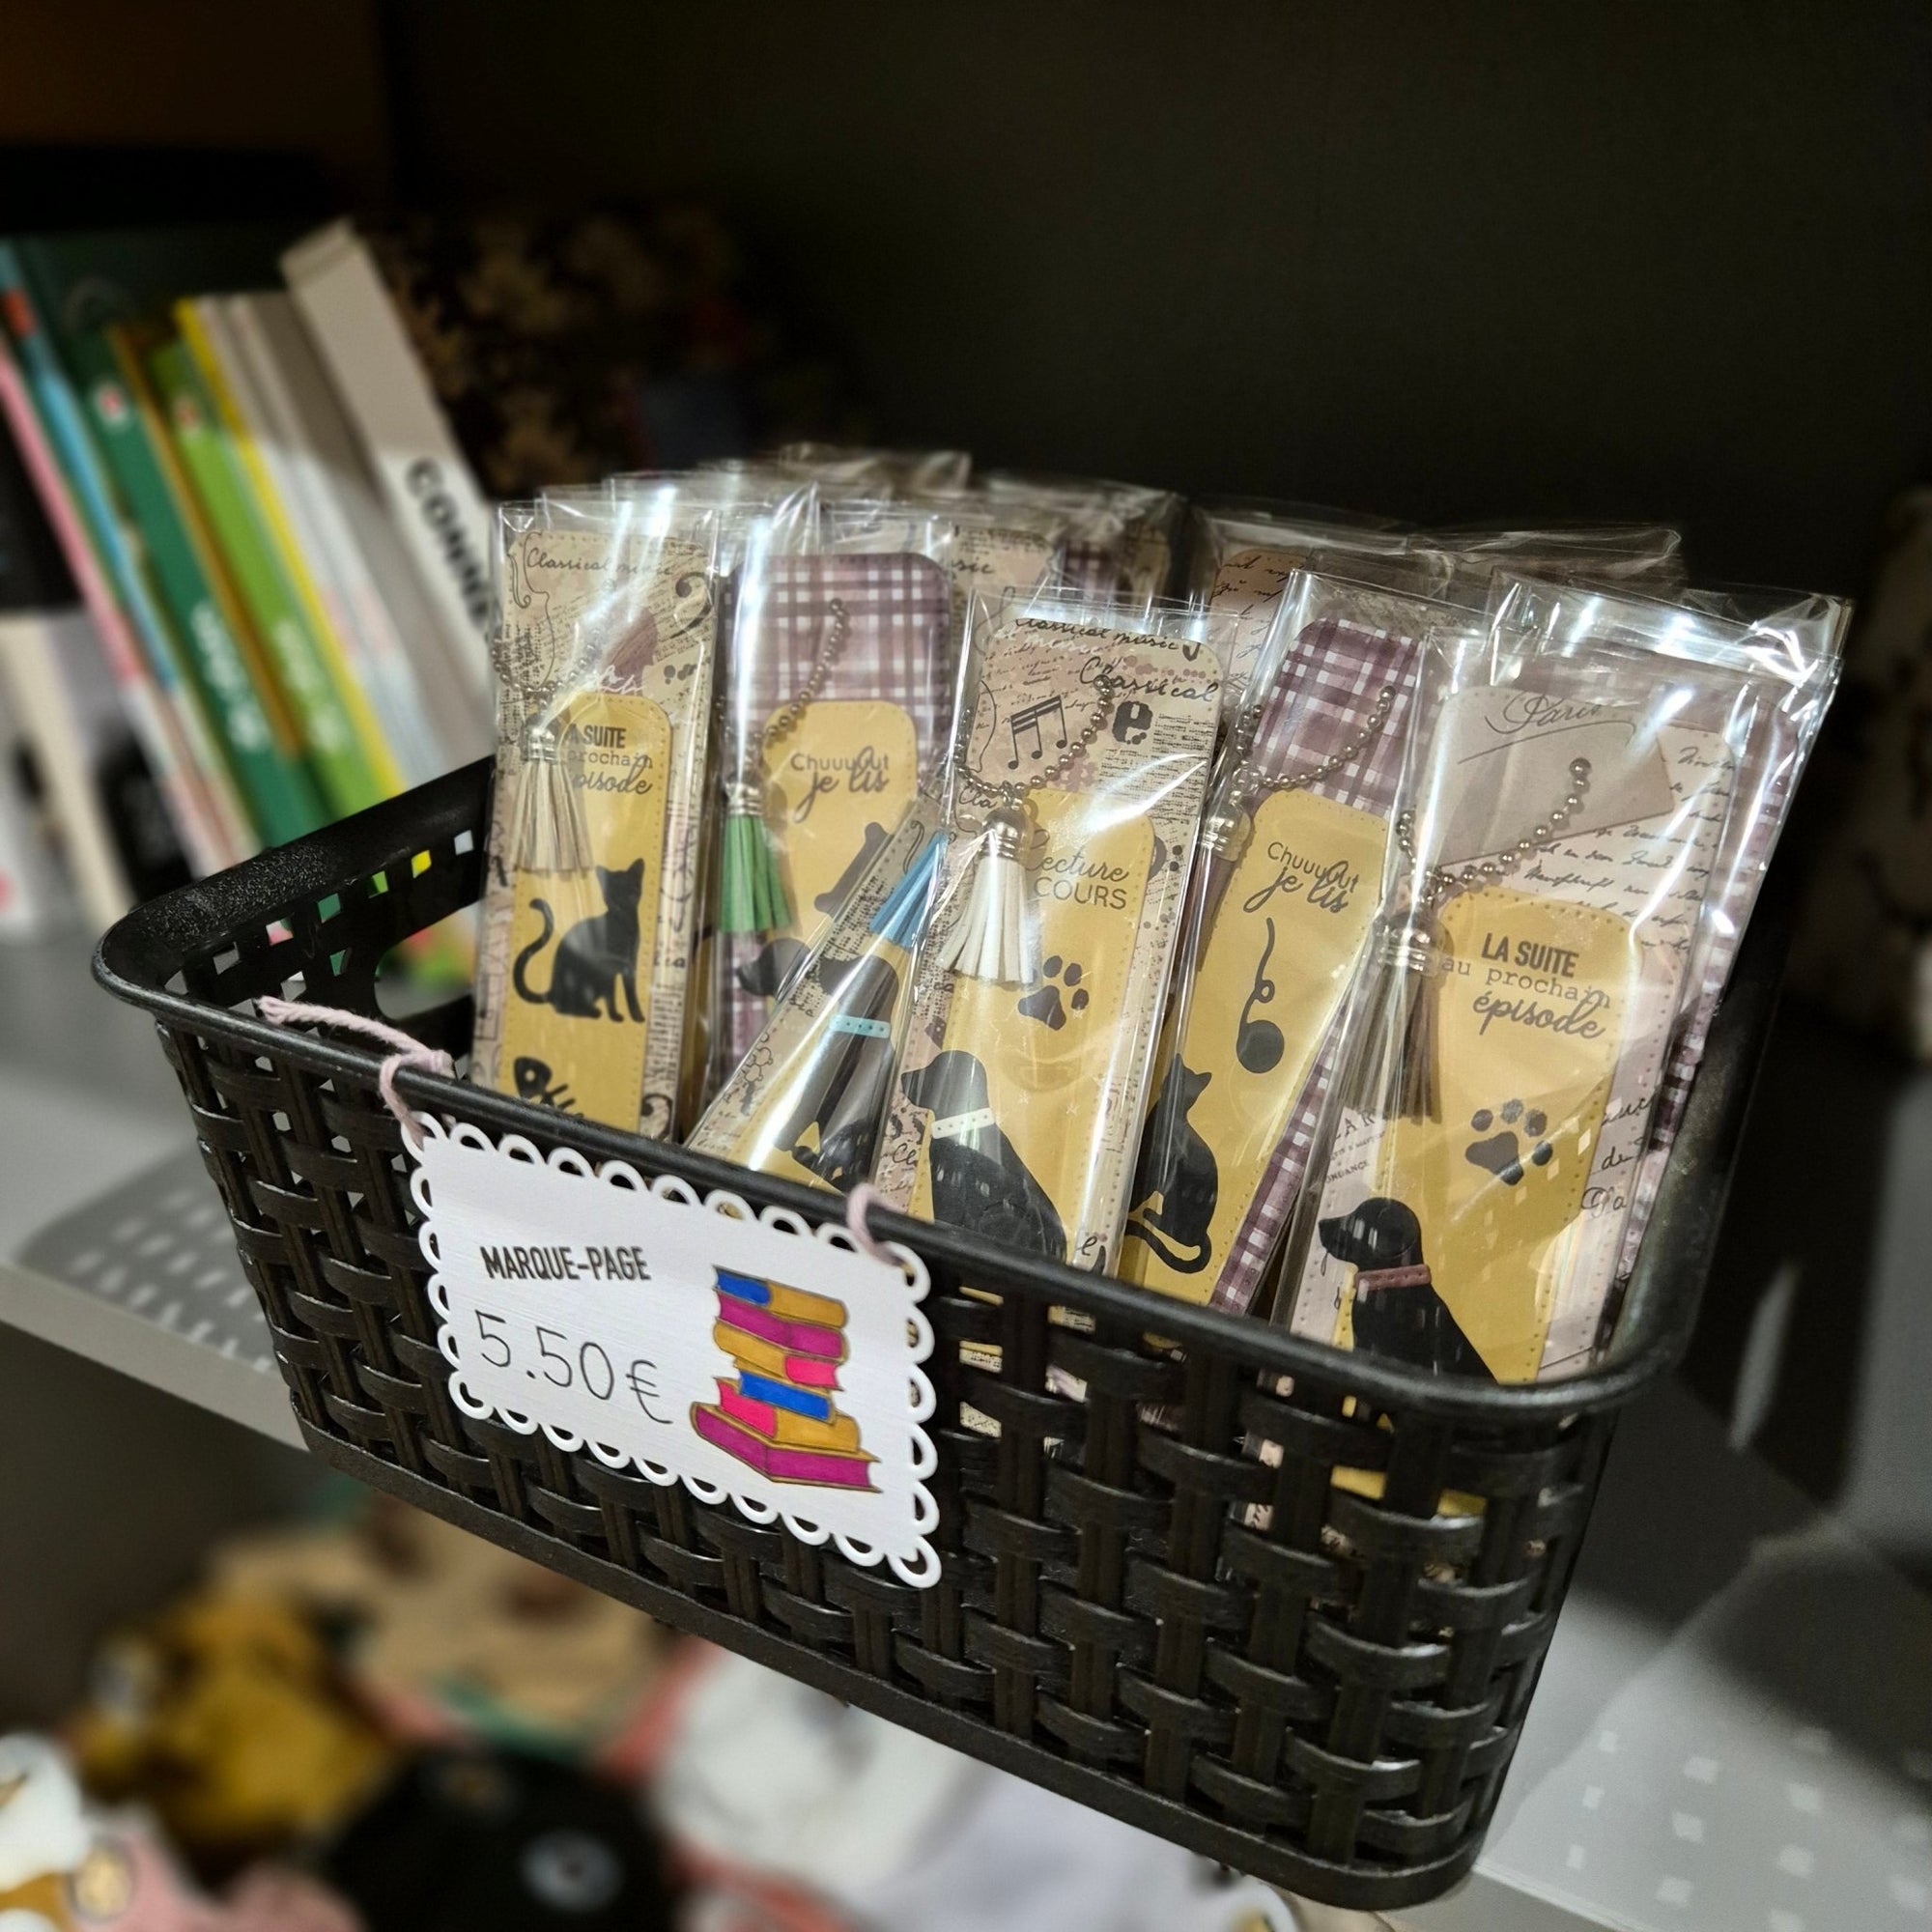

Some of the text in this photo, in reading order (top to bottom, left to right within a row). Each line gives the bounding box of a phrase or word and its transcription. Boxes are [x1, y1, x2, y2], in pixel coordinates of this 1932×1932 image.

[526, 547, 611, 570] Classical
[1114, 632, 1179, 651] music
[582, 724, 627, 750] SUITE
[793, 745, 891, 825] je lis
[1034, 876, 1127, 910] COURS
[1242, 860, 1350, 914] je lis
[1481, 932, 1580, 979] LA SUITE
[1441, 955, 1611, 1010] au prochain
[1472, 989, 1606, 1040] épisode
[479, 1245, 652, 1281] MARQUE-PAGE
[474, 1309, 674, 1425] 5.50€
